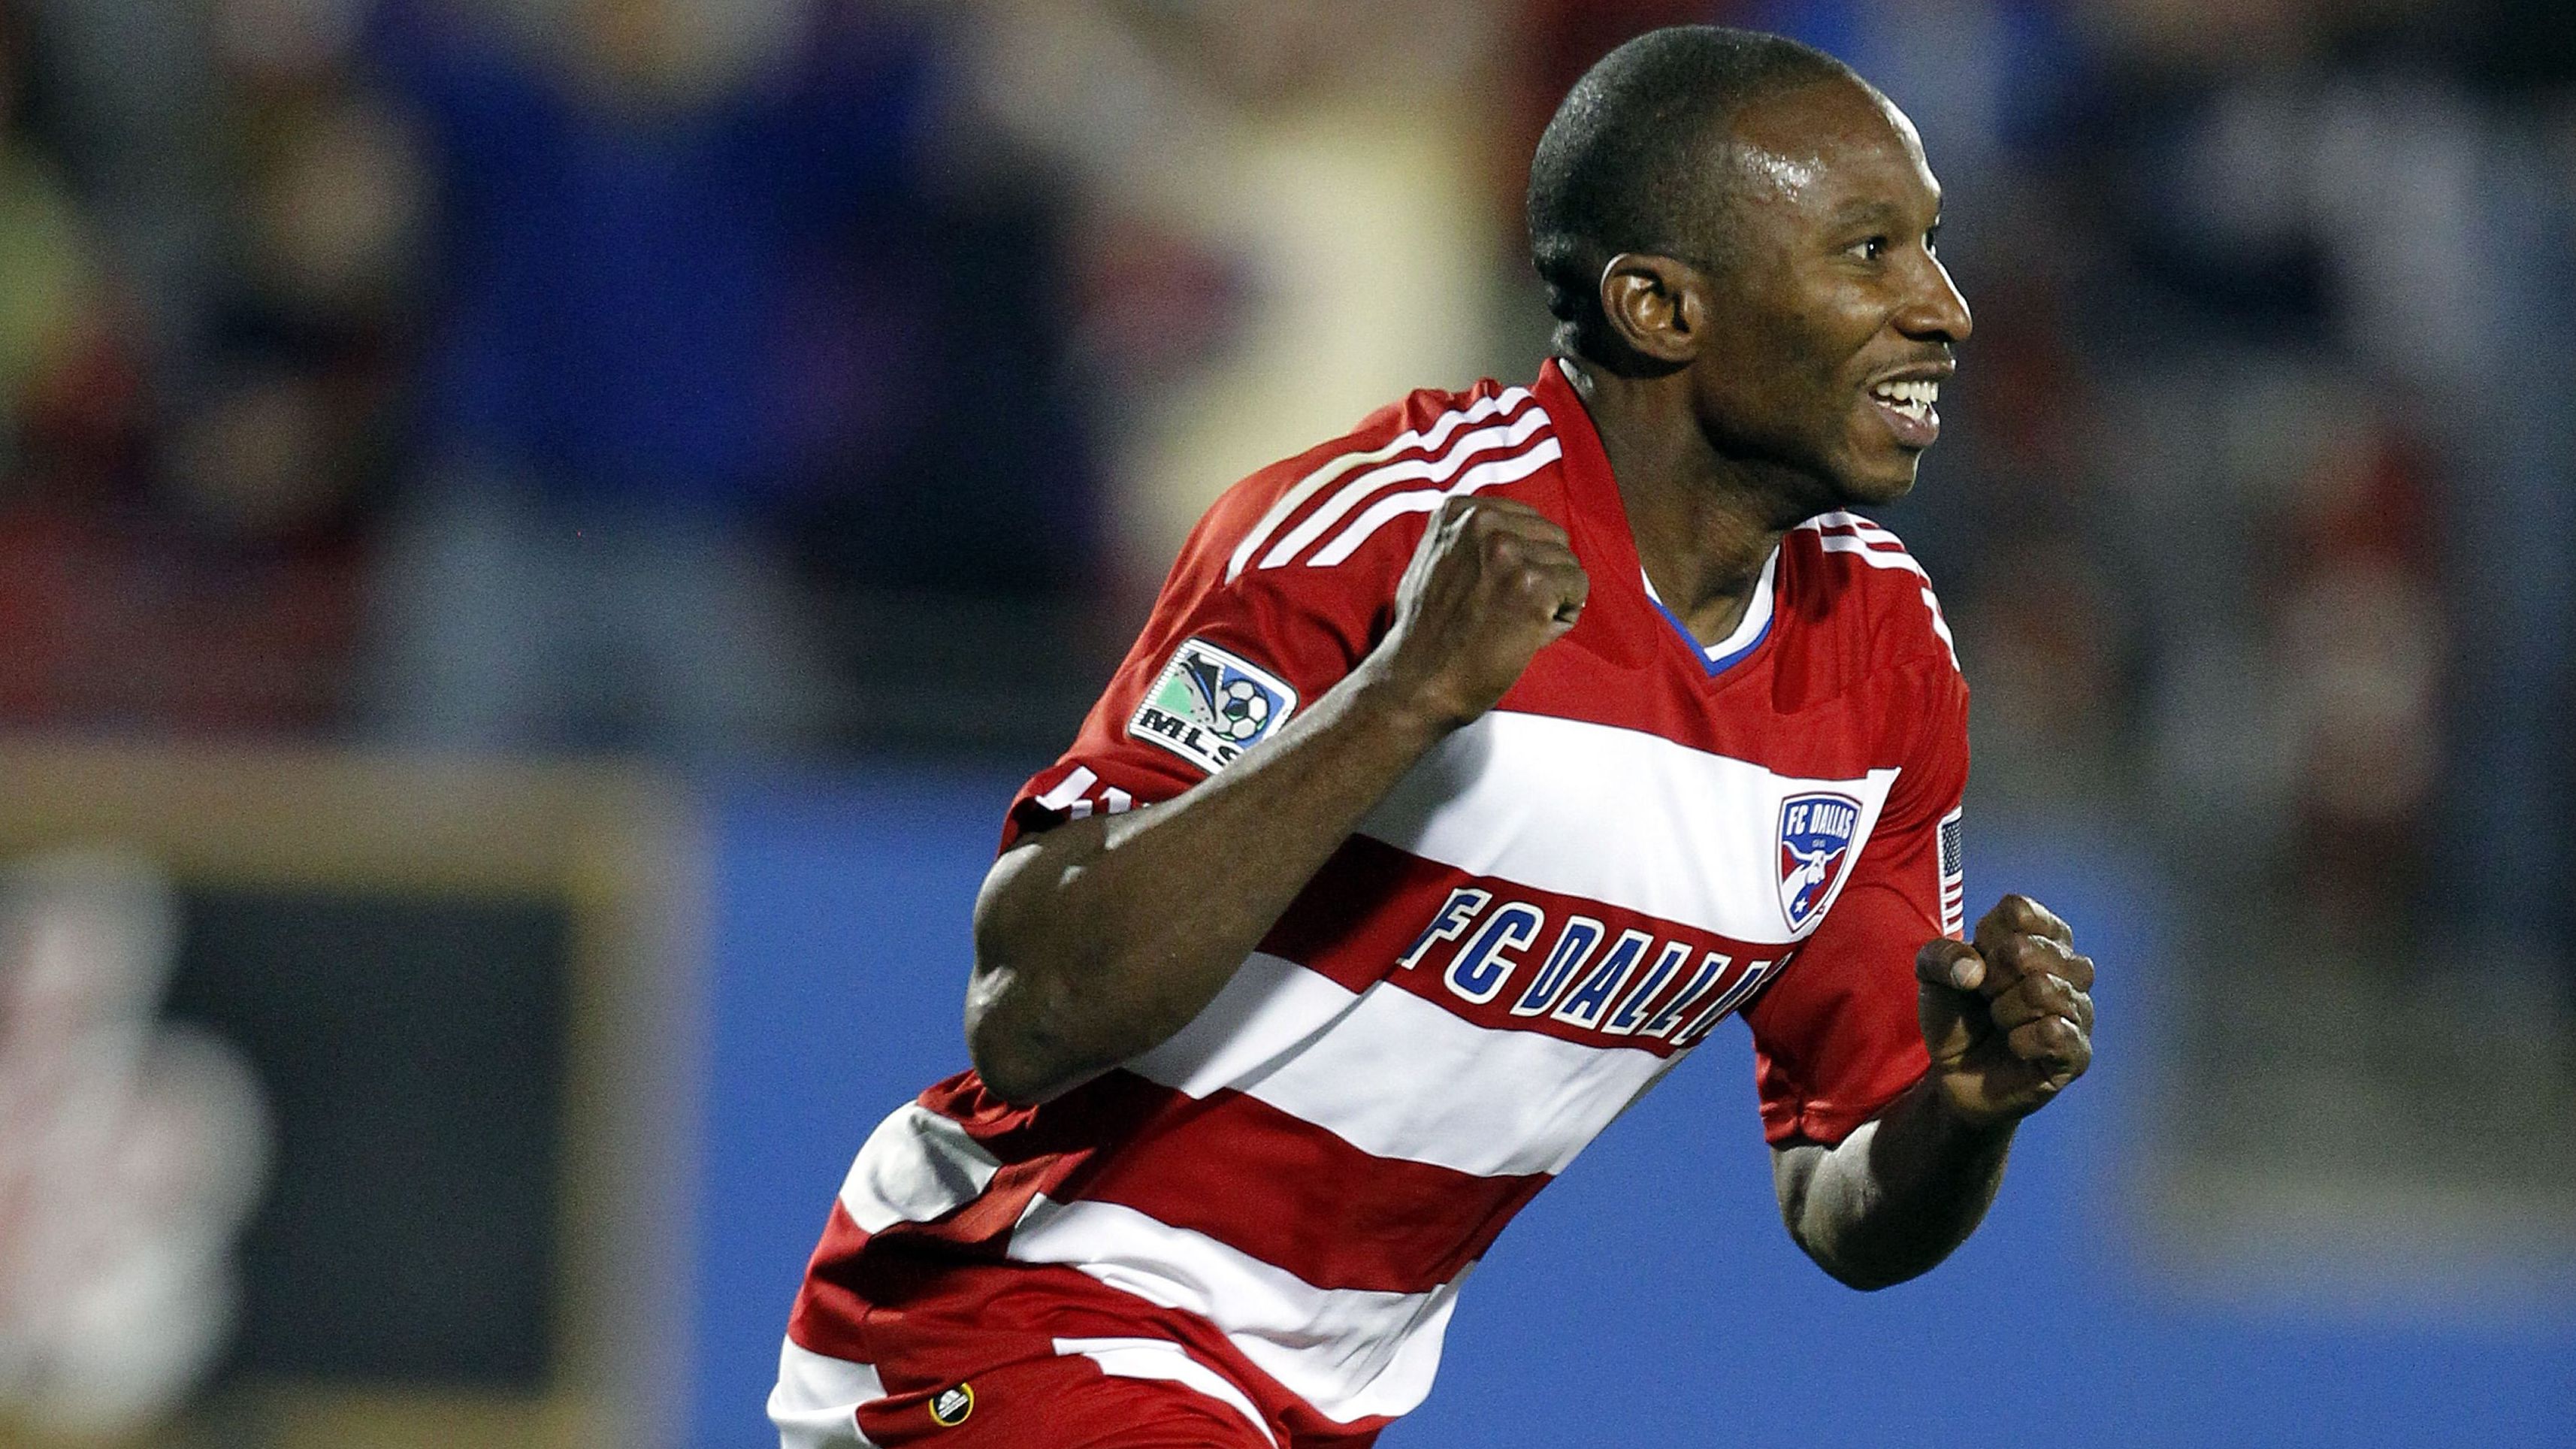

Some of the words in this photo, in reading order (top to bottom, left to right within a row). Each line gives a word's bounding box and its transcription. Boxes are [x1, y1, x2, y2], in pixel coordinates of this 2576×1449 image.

[1786, 805, 1809, 836] FC
[1810, 804, 1854, 839] DALLAS
[1395, 887, 1546, 1006] FC
[1508, 915, 1793, 1046] DALL
